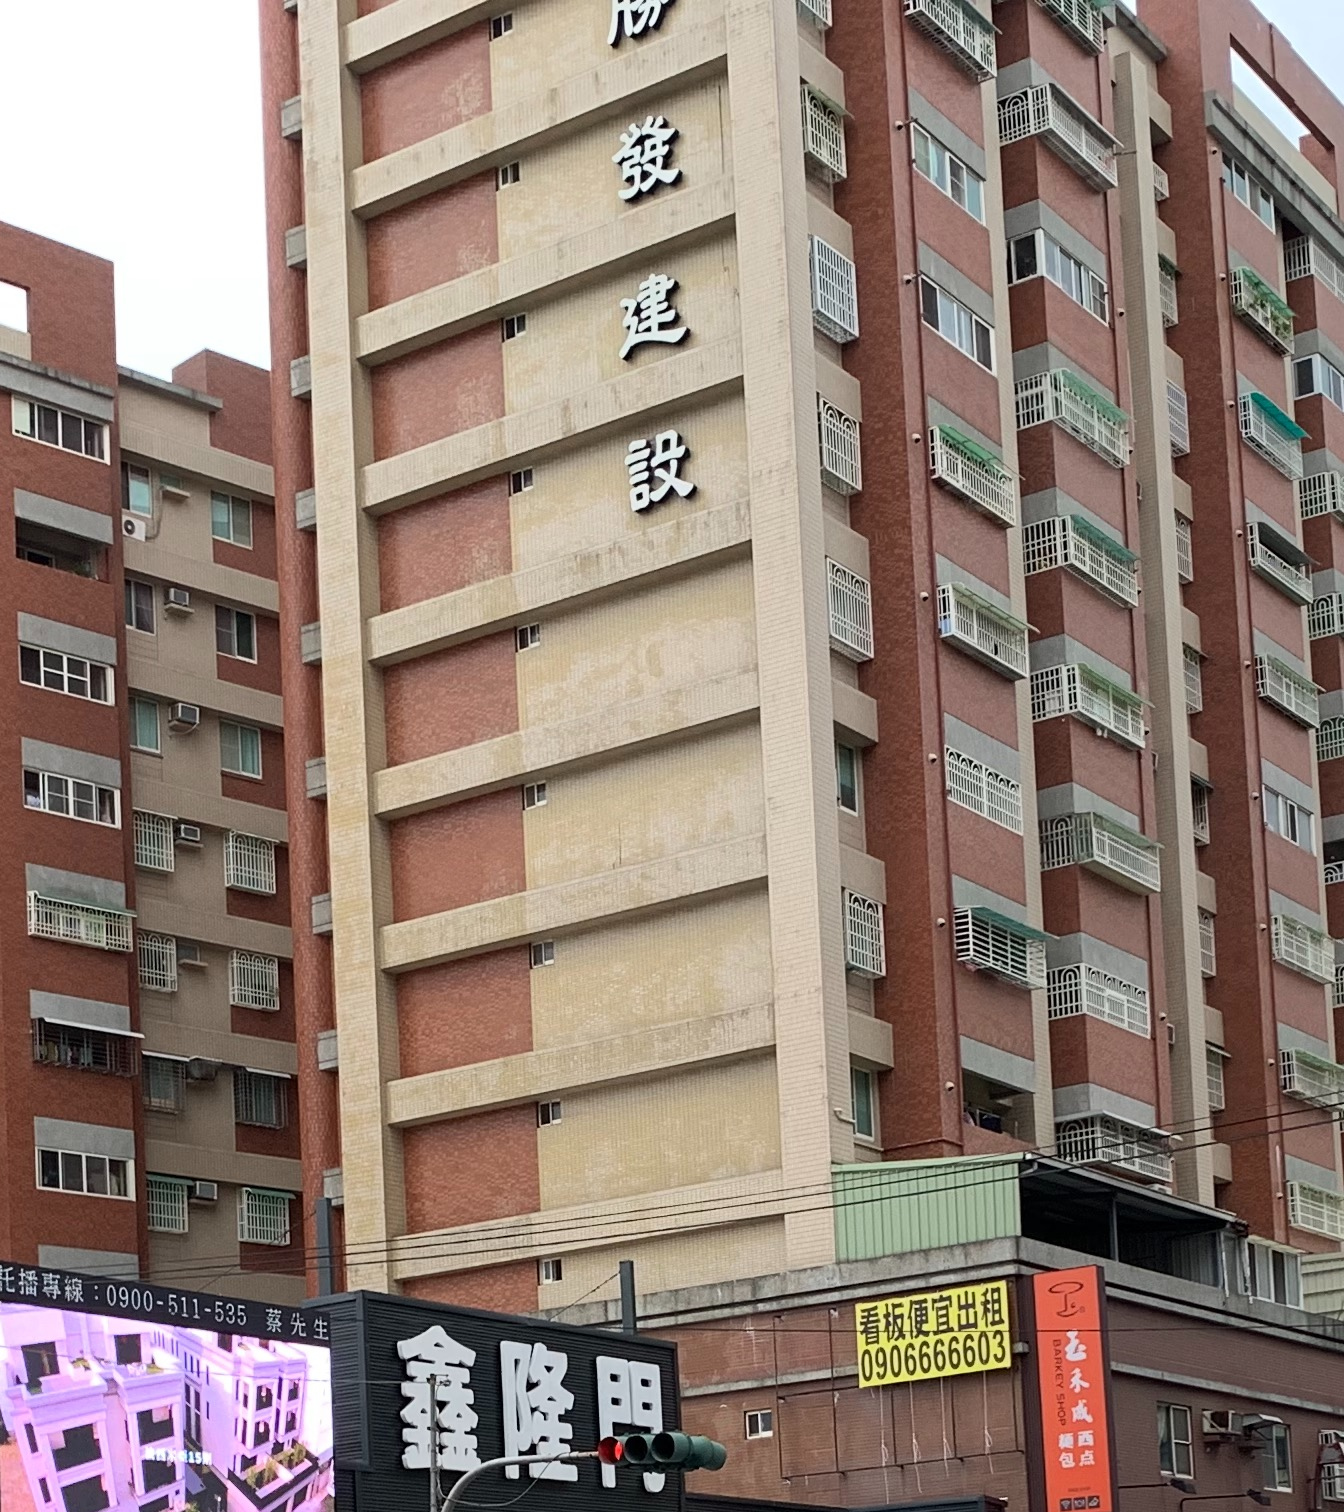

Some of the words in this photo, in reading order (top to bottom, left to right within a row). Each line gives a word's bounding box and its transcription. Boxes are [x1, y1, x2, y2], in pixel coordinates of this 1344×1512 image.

[265, 1308, 330, 1341] 蔡先生
[859, 1286, 1005, 1347] 看板便宜出租
[861, 1329, 1006, 1382] 0906666603
[397, 1325, 666, 1493] 鑫隆門
[1055, 1393, 1067, 1427] SHOP
